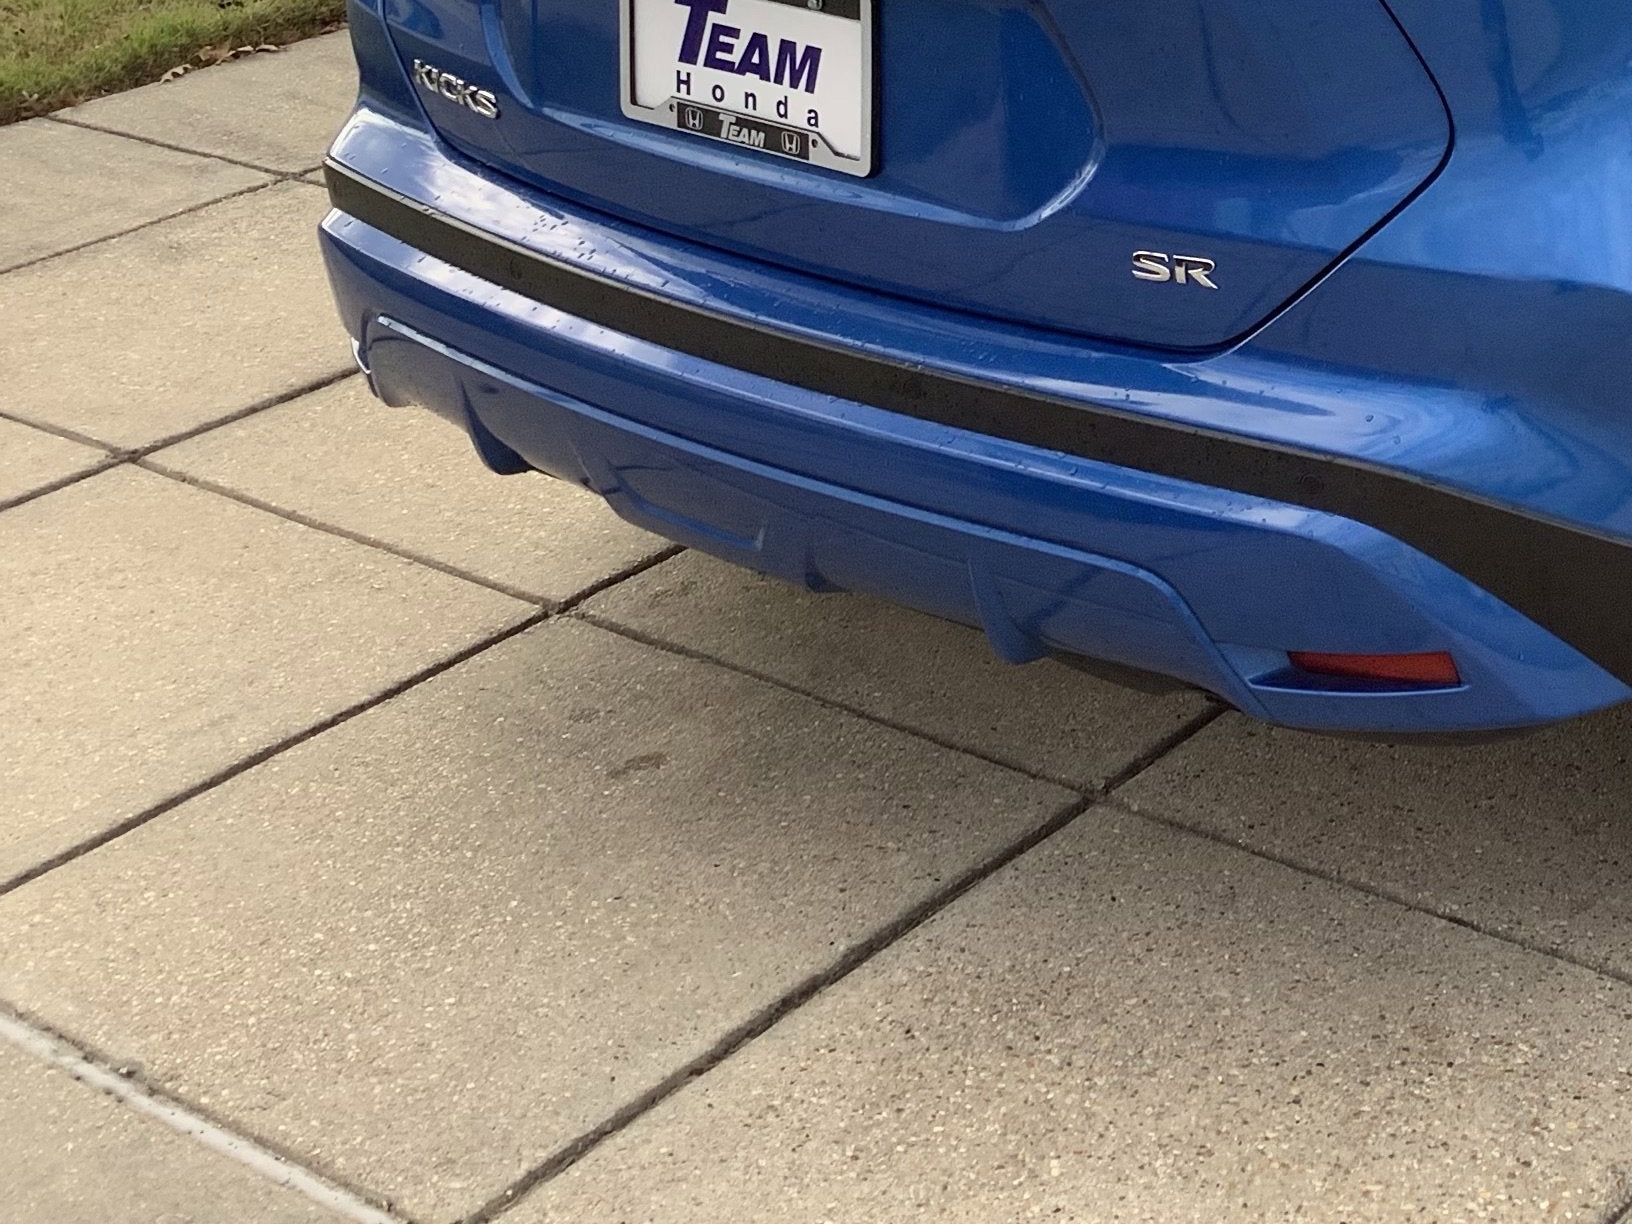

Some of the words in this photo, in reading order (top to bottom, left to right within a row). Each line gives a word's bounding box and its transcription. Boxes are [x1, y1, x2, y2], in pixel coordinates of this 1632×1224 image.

[413, 59, 498, 119] KICKS
[676, 70, 819, 128] Honda
[718, 113, 766, 148] TEAM
[1132, 250, 1218, 289] SR
